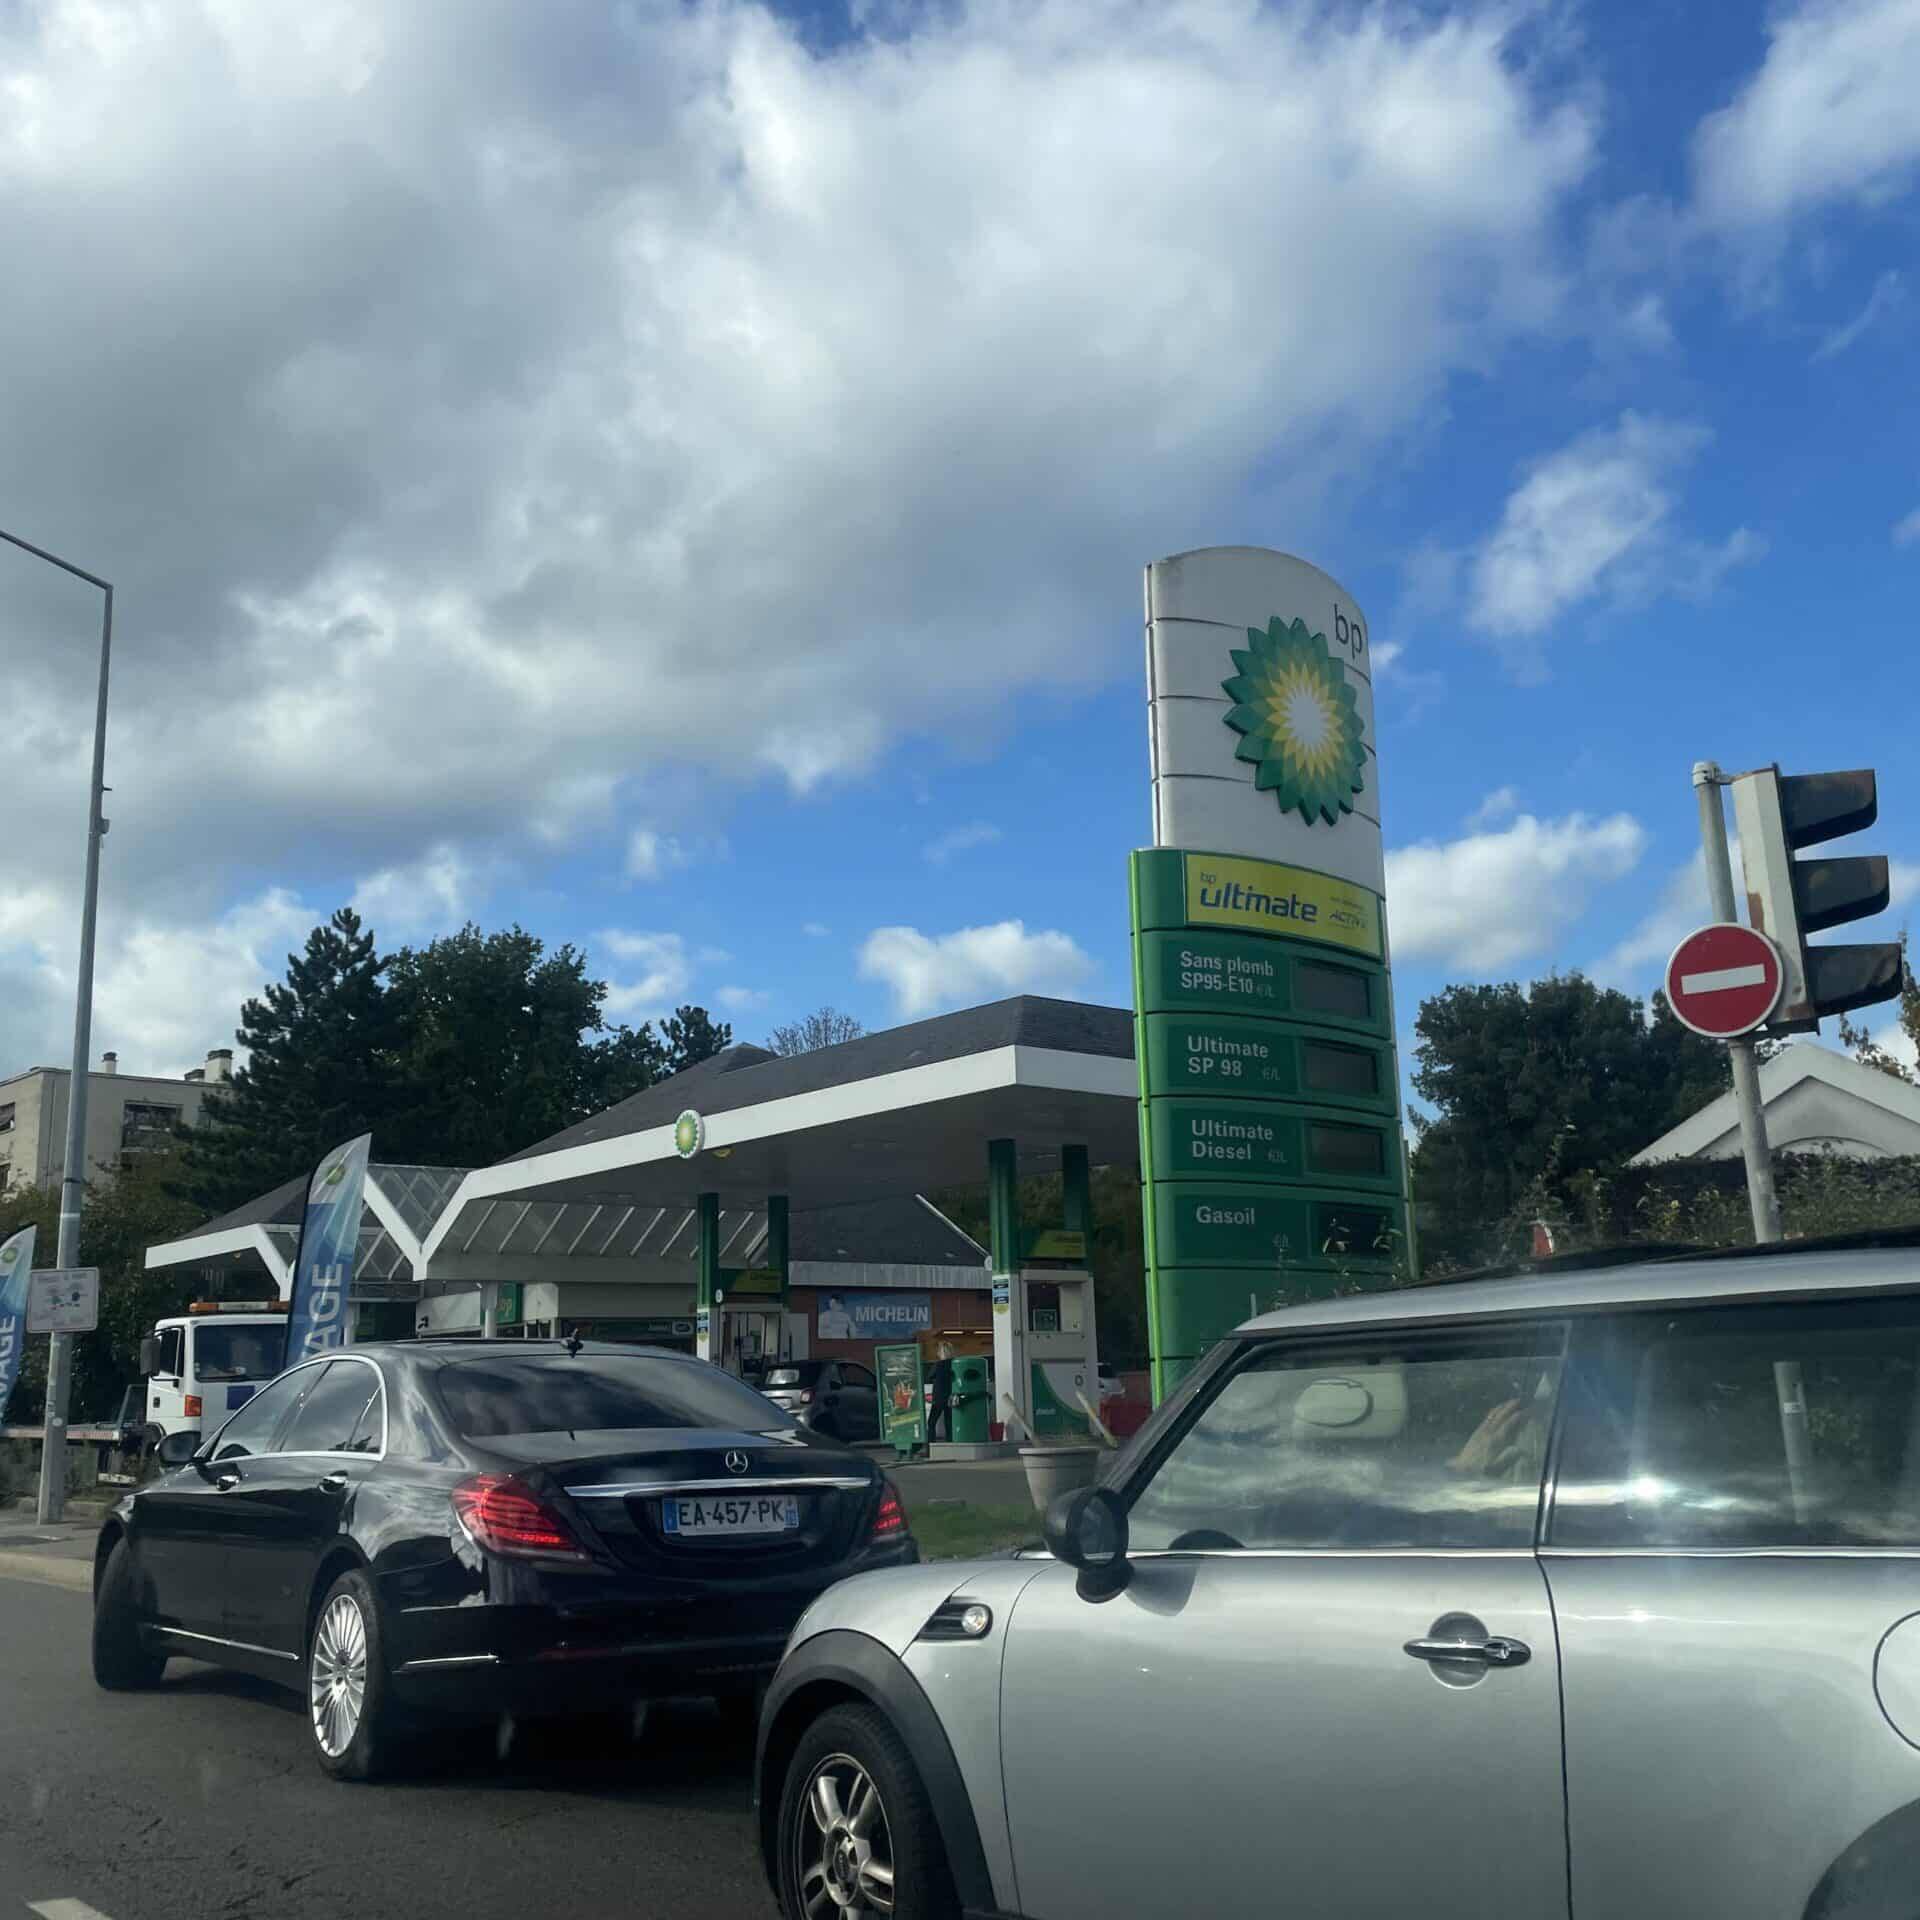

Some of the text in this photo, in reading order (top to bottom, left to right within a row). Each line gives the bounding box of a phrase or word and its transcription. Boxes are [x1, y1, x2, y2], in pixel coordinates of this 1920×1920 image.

[1334, 603, 1363, 660] bp
[1200, 882, 1318, 924] ultimate
[1180, 950, 1274, 977] Sans plomb
[1180, 971, 1254, 994] SP95-E10
[1187, 1035, 1269, 1058] Ultimate
[1187, 1056, 1214, 1074] SP
[1220, 1059, 1243, 1077] 98
[1191, 1119, 1274, 1141] Ultimate
[1191, 1140, 1252, 1160] Diesel
[1195, 1205, 1256, 1225] Gasoil
[303, 1263, 343, 1357] AGE
[855, 1305, 929, 1323] MICHELIN
[679, 1500, 785, 1526] EA-457-PK
